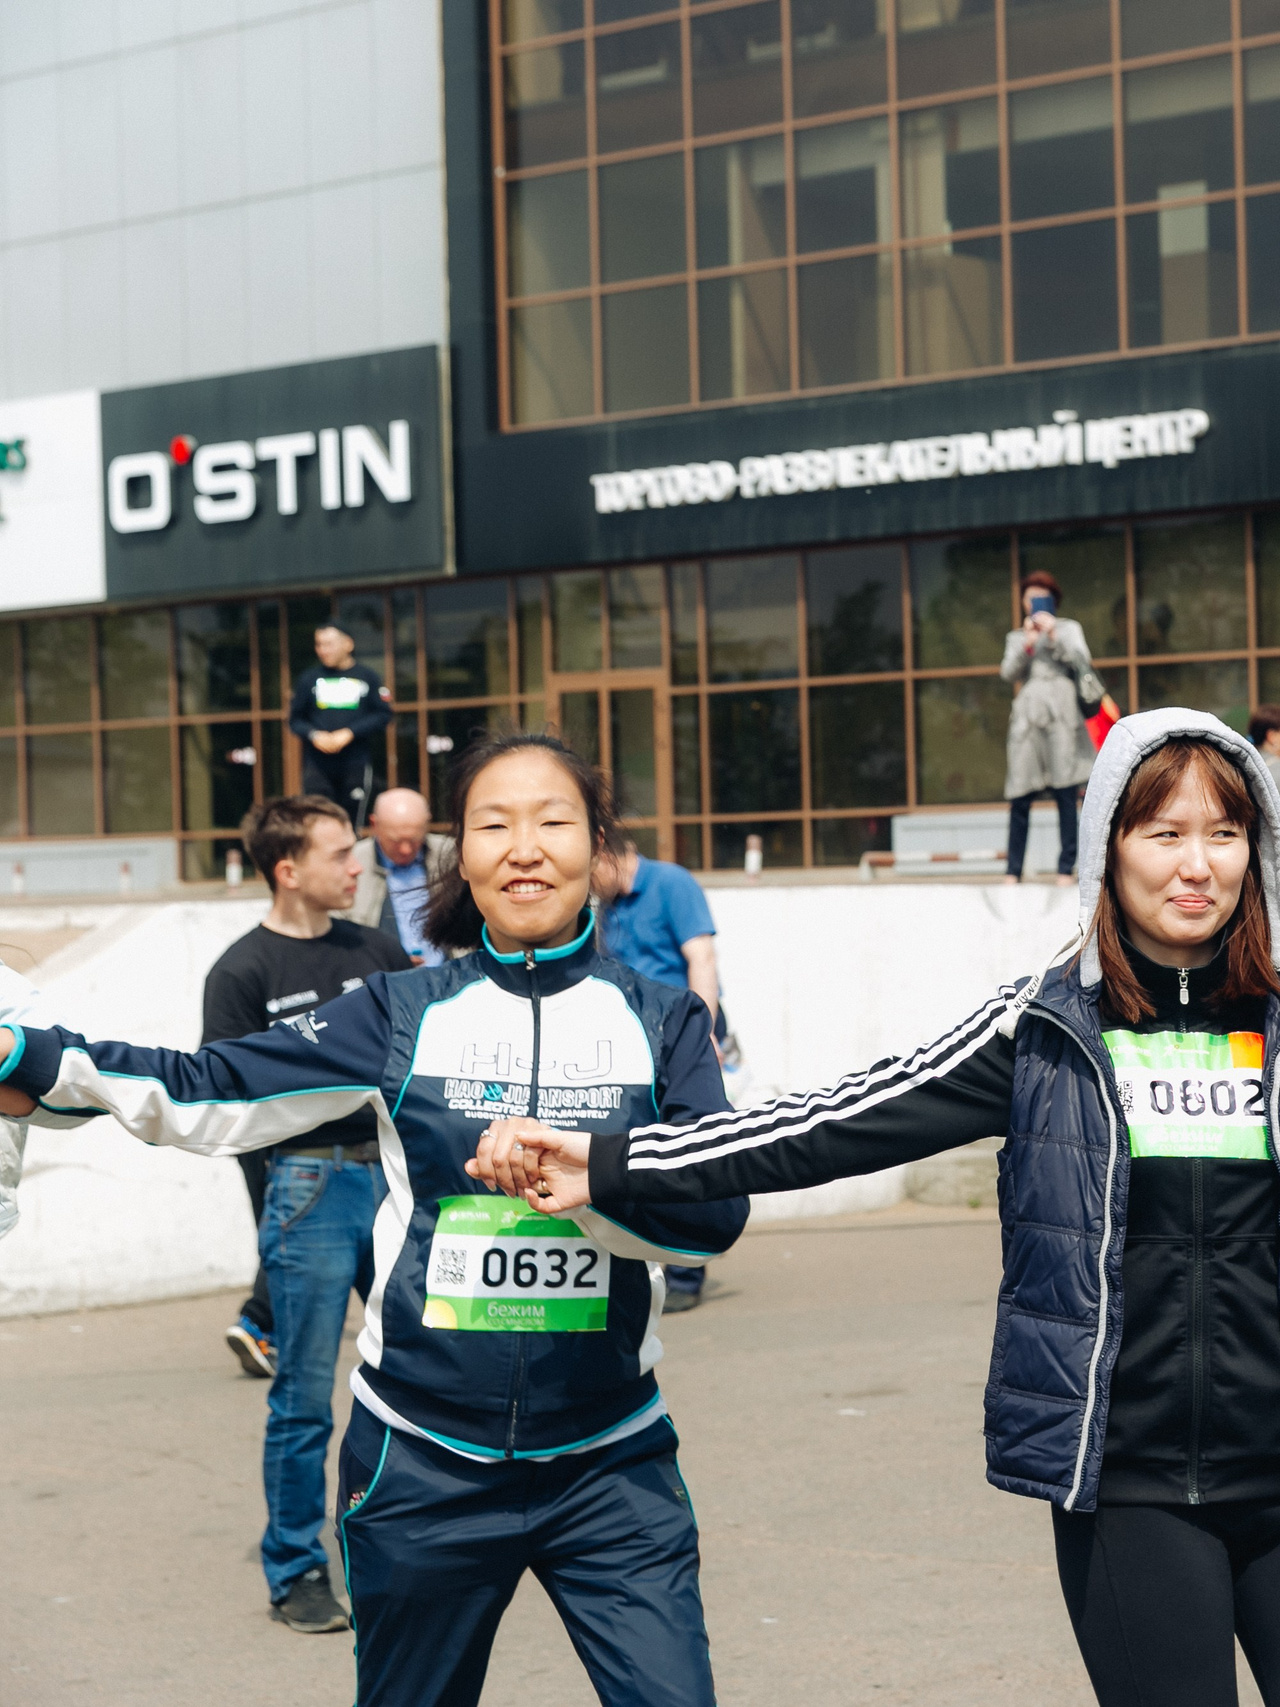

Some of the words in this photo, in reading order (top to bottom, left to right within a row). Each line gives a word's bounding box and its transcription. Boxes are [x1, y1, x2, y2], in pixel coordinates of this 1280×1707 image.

[107, 419, 411, 533] O'STIN
[444, 1078, 485, 1099] HAO
[1150, 1078, 1266, 1116] 0602
[481, 1248, 598, 1289] 0632
[487, 1302, 545, 1317] бежим
